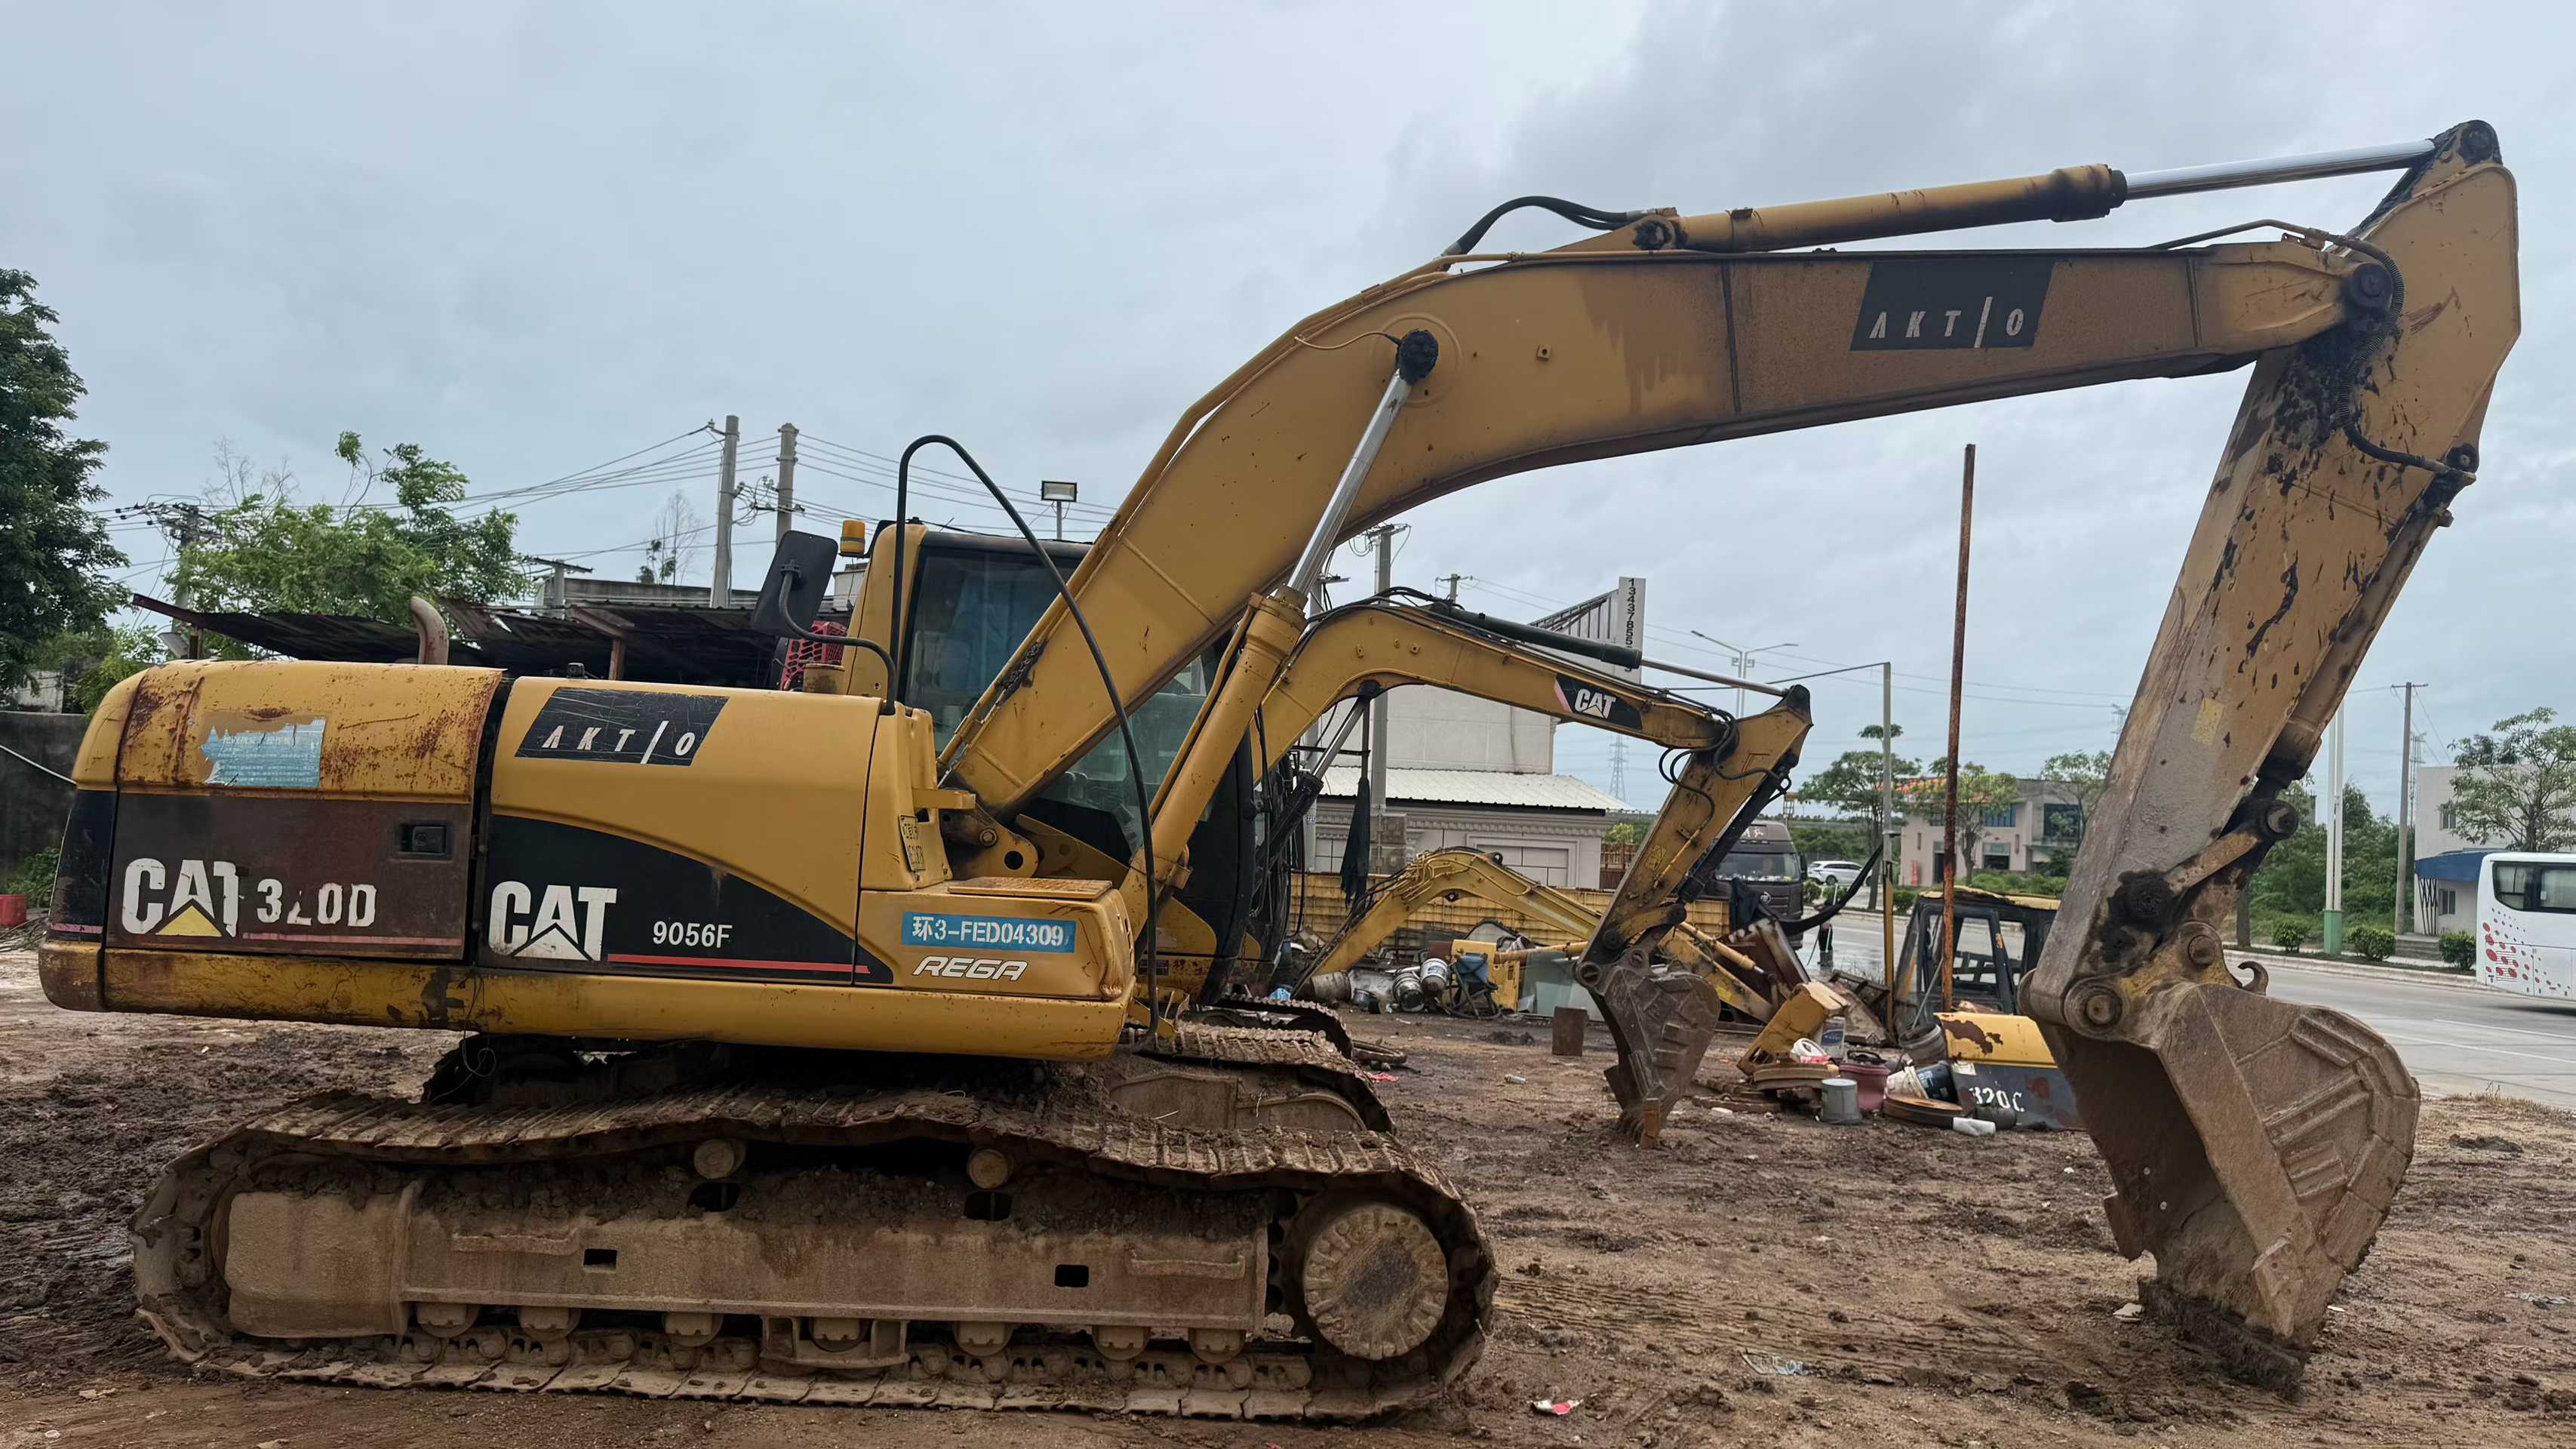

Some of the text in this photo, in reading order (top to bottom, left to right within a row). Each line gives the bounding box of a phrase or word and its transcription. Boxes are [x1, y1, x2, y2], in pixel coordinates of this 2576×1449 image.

[1574, 688, 1616, 719] CAT
[121, 857, 244, 938] CAT
[488, 880, 733, 962] CAT 9056F
[911, 955, 1028, 981] REGA
